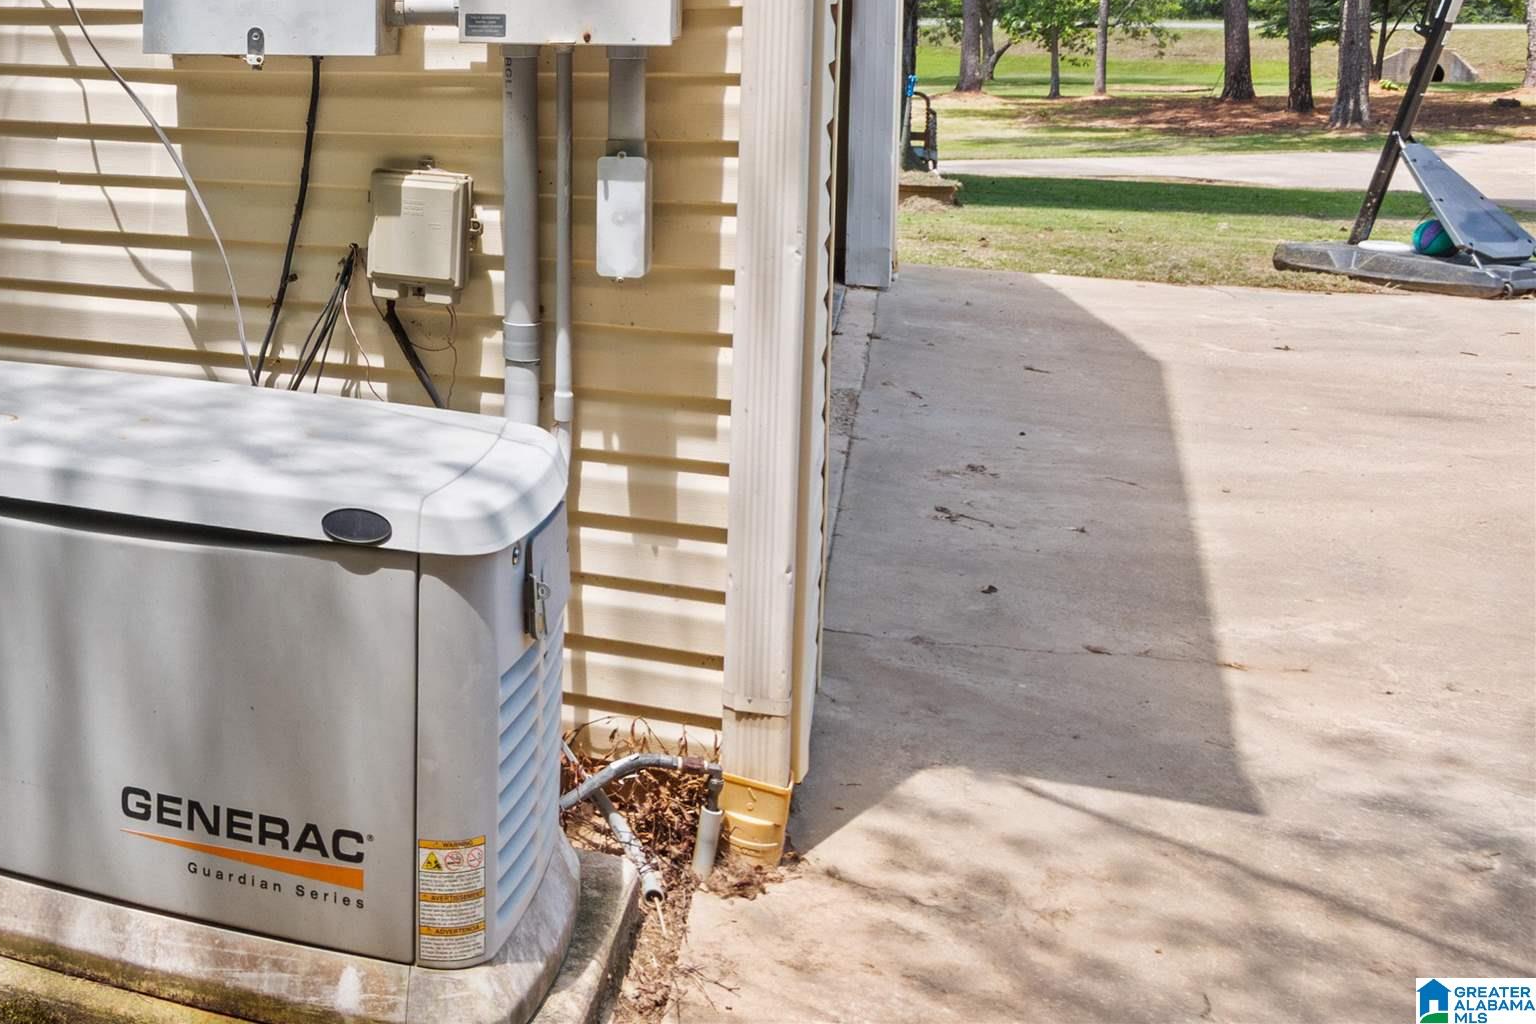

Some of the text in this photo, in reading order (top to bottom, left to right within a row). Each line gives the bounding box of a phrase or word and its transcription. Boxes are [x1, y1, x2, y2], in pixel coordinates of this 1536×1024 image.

[121, 786, 364, 864] GENERAC
[187, 861, 364, 909] Guardian Series
